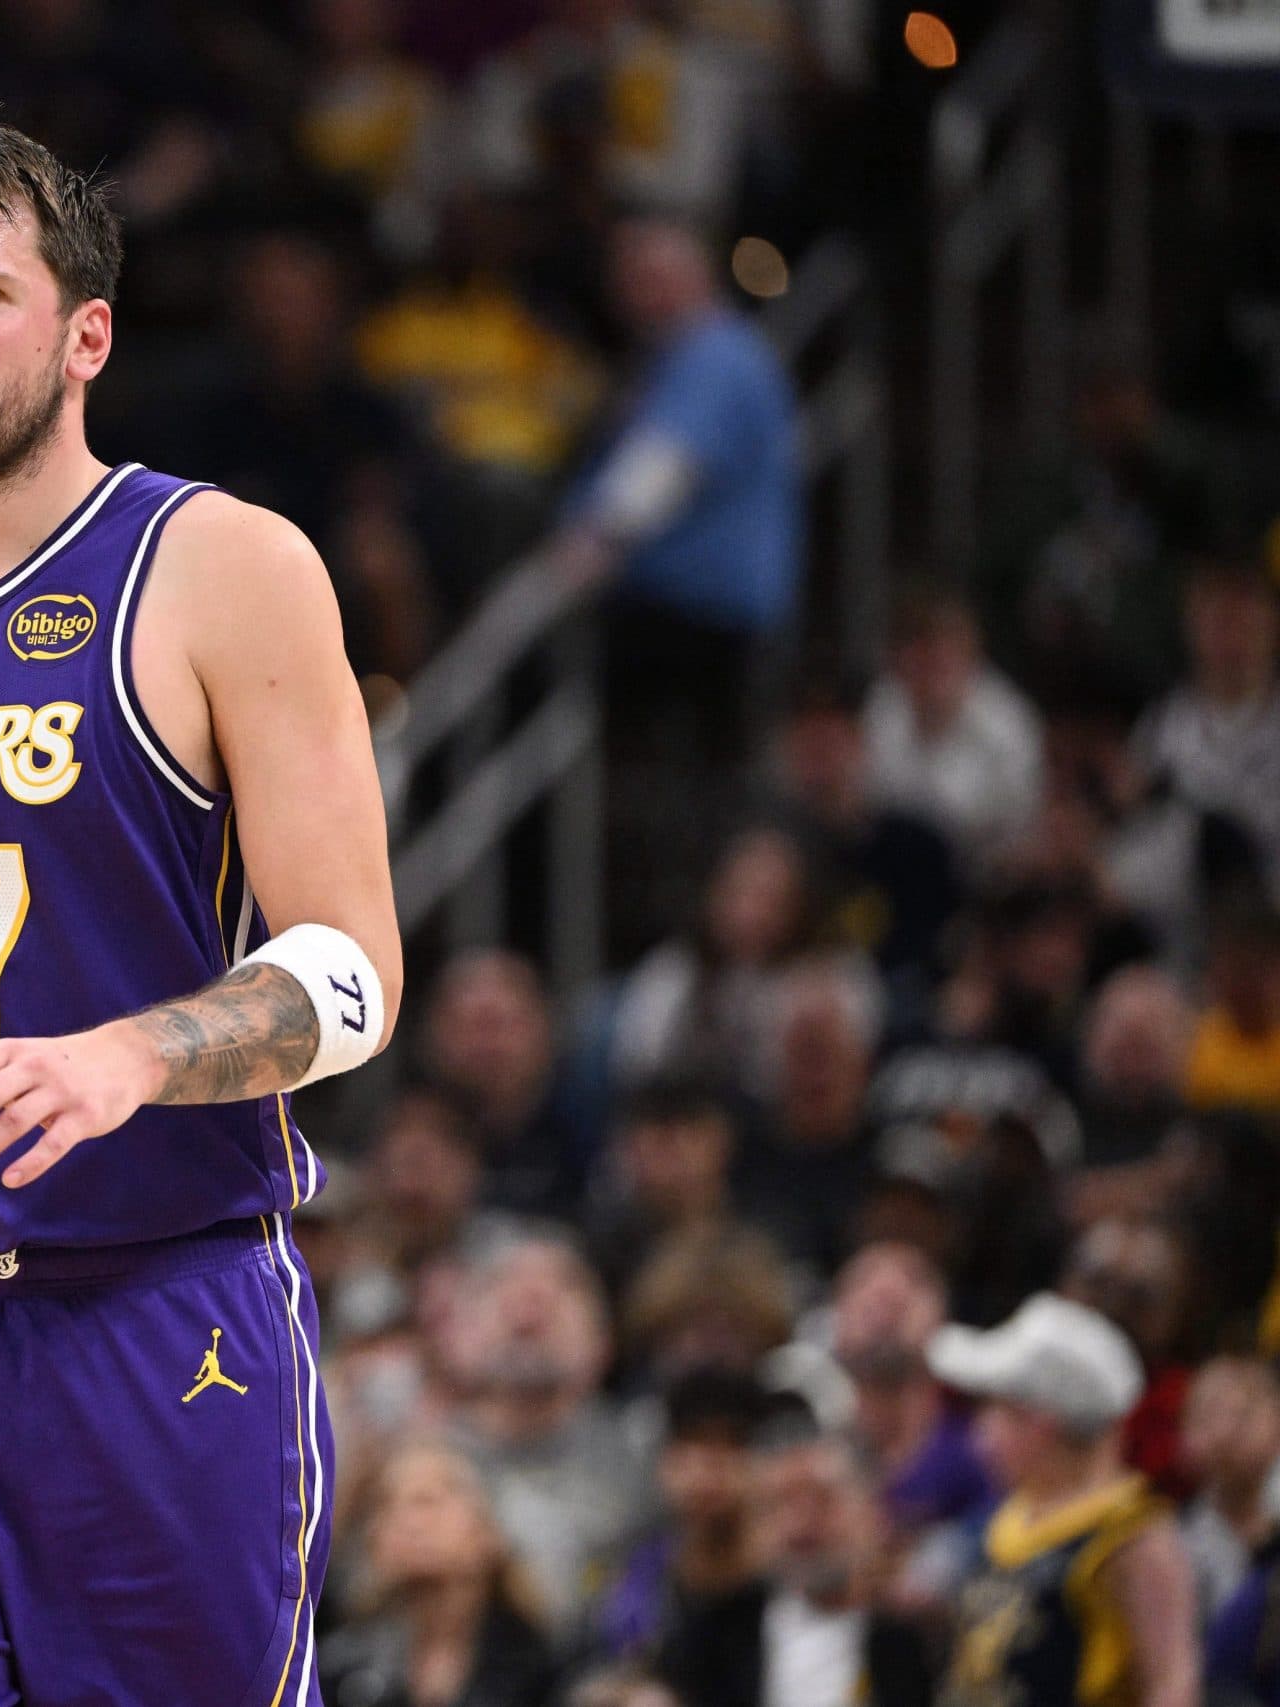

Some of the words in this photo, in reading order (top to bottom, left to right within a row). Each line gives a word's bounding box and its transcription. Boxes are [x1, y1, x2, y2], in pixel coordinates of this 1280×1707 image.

[16, 612, 91, 640] bibigo
[26, 634, 58, 646] 비비고
[328, 969, 366, 1034] 77
